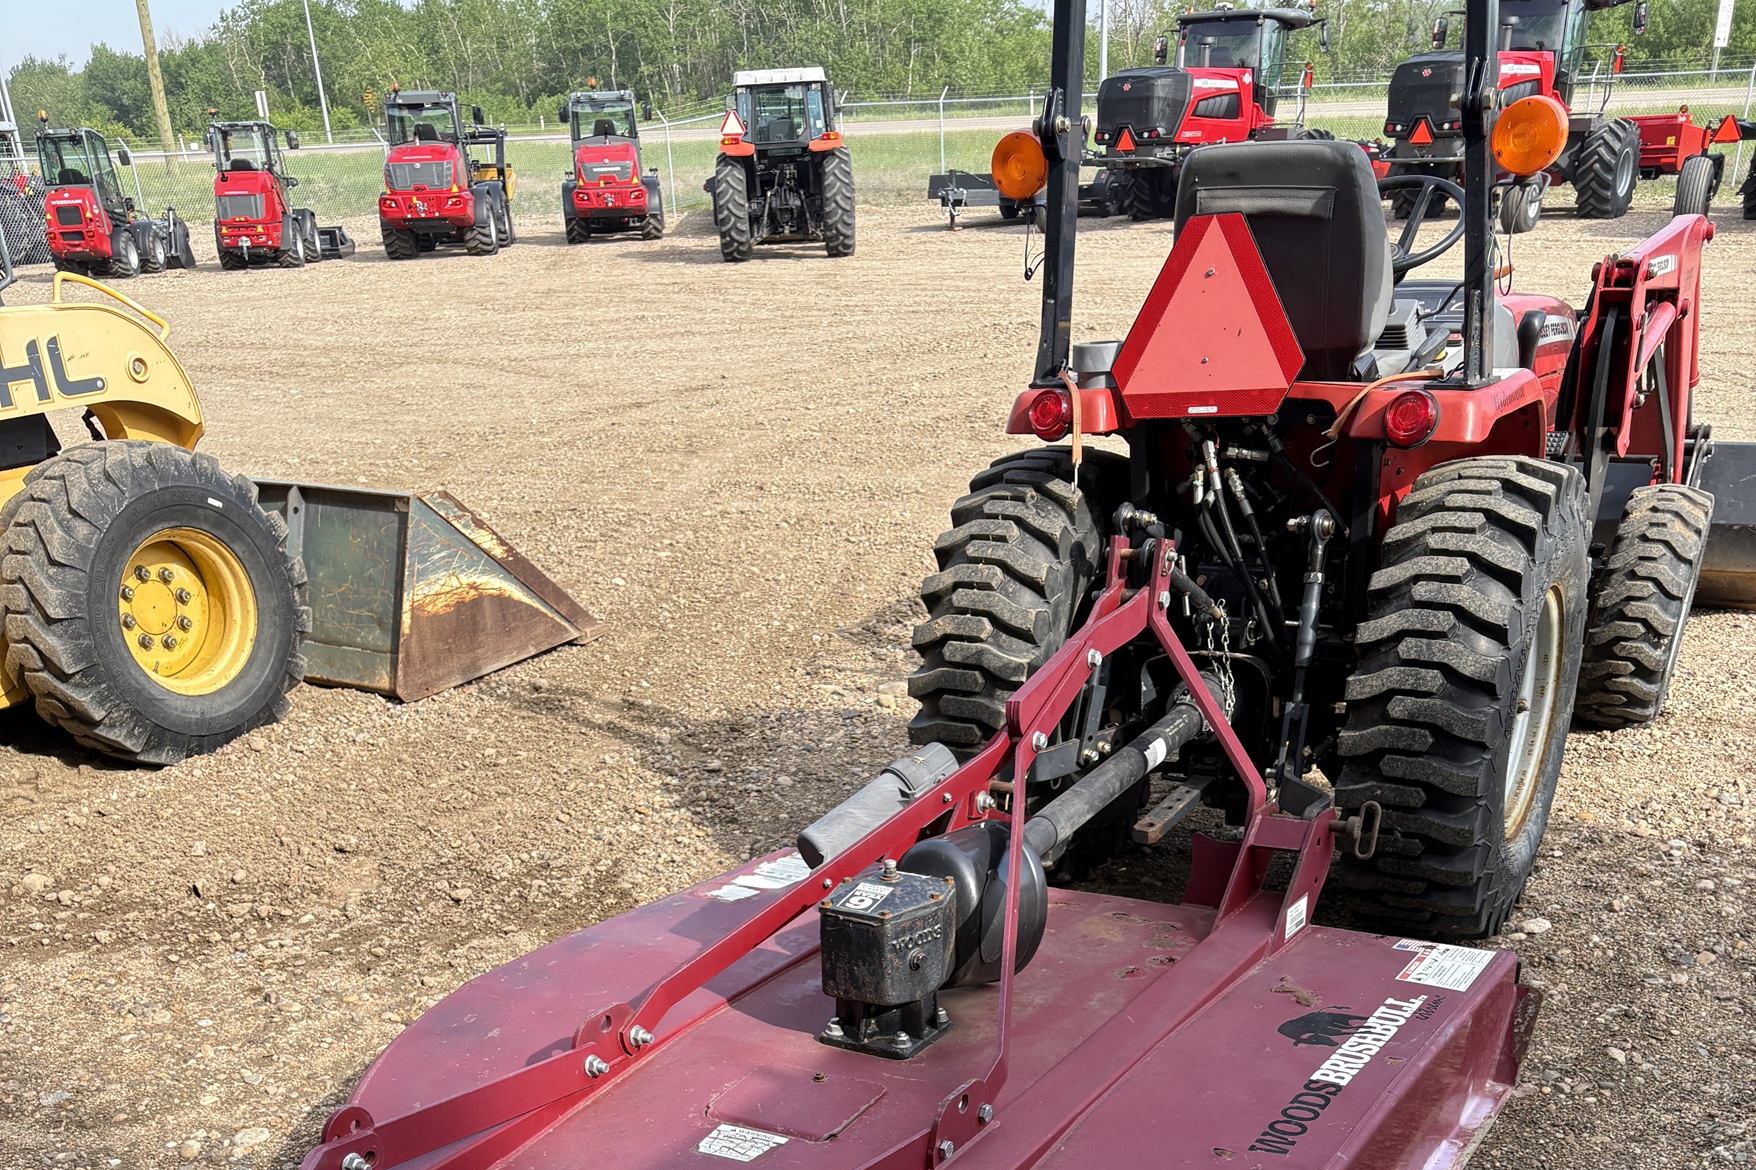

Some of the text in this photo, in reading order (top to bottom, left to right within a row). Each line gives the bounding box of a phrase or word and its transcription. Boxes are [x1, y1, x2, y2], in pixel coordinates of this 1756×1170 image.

[845, 896, 874, 909] 6
[892, 924, 942, 953] WOODS
[1248, 995, 1427, 1156] WOODS BRUSHBULL
[738, 1128, 775, 1140] WARNING
